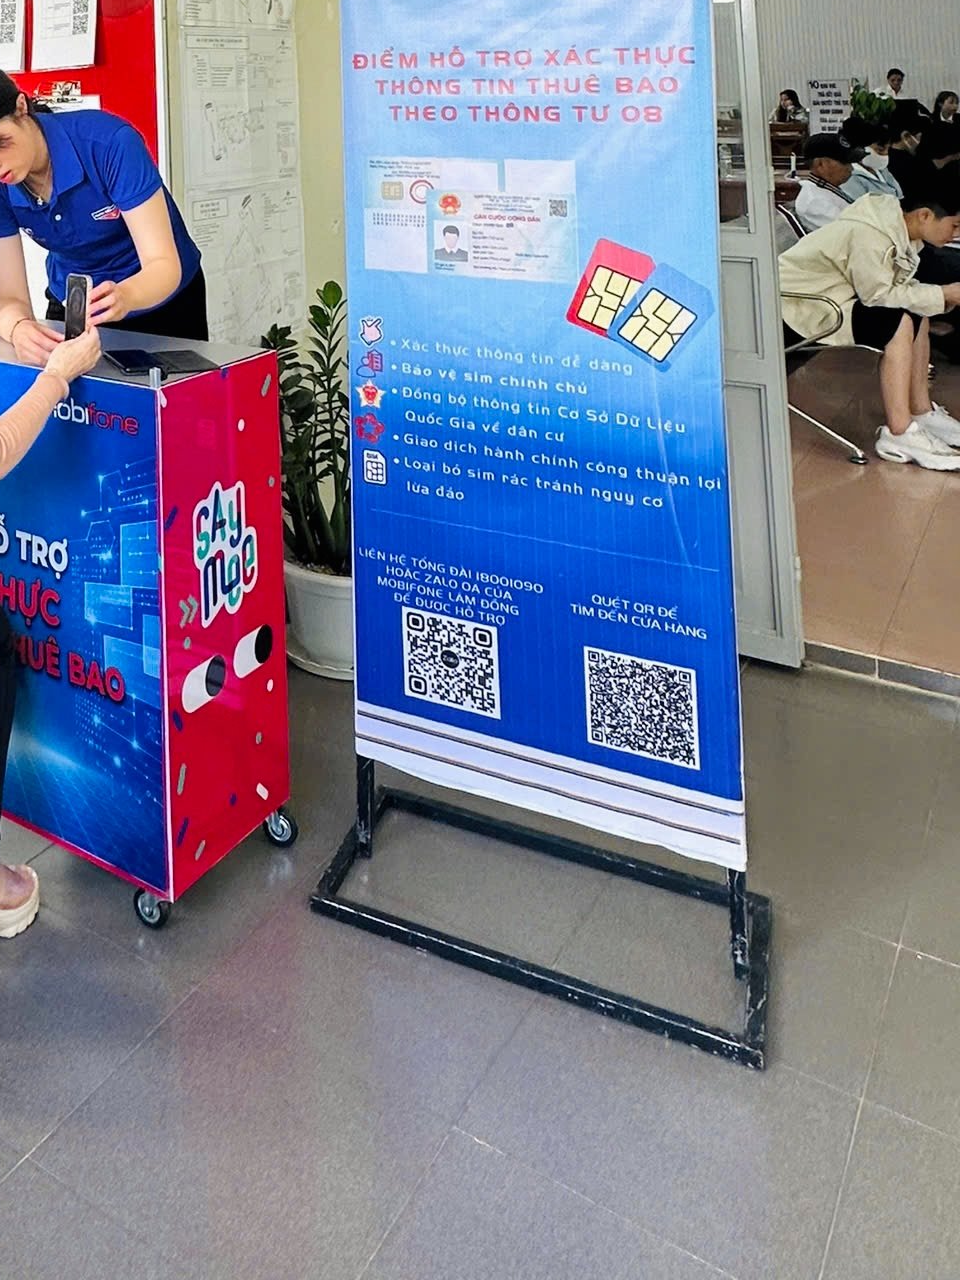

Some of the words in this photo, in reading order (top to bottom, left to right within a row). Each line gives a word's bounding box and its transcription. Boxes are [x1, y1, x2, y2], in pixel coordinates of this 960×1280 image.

[352, 46, 418, 70] ĐIỂM
[430, 45, 466, 68] HỖ
[476, 48, 532, 70] TRỢ
[543, 44, 602, 67] XÁC
[614, 44, 696, 69] THỰC
[375, 76, 461, 95] THÔNG
[472, 78, 515, 95] TIN
[527, 73, 601, 95] THUÊ
[615, 76, 679, 94] BAO
[389, 105, 458, 121] THEO
[467, 102, 560, 122] THÔNG
[572, 104, 610, 123] TƯ
[621, 105, 663, 123] 08
[401, 338, 429, 352] Xác
[435, 341, 470, 357] thực
[476, 346, 524, 364] thông
[531, 352, 554, 365] tin
[464, 371, 493, 384] sim
[53, 397, 139, 435] obifone
[448, 390, 467, 406] bộ
[474, 395, 520, 415] thông
[528, 402, 551, 416] tin
[557, 405, 580, 420] Cơ
[586, 408, 609, 424] Sở
[615, 412, 640, 428] Dữ
[647, 417, 687, 434] Liệu
[405, 410, 444, 426] Quốc
[449, 416, 476, 431] Gia
[482, 419, 501, 434] về
[507, 422, 538, 439] dân
[545, 430, 565, 443] cư
[403, 432, 438, 449] Giao
[443, 439, 478, 456] dịch
[483, 445, 525, 462] hành
[531, 452, 579, 470] chính
[585, 461, 628, 479] công
[635, 467, 690, 487] thuận
[698, 475, 722, 492] lợi
[404, 456, 436, 473] Loại
[442, 461, 461, 477] bỏ
[467, 467, 495, 482] sim
[501, 473, 529, 488] rác
[535, 476, 584, 496] tránh
[591, 487, 635, 506] nguy
[642, 495, 664, 508] cơ
[406, 480, 430, 496] lừa
[15, 528, 69, 580] TRỢ
[359, 547, 386, 561] LIÊN
[449, 564, 472, 579] ĐÀI
[476, 571, 544, 594] 18001090
[377, 575, 444, 599] MOBIFONE
[424, 573, 458, 589] ZALO
[461, 581, 481, 594] OA
[484, 584, 513, 601] CỦA
[478, 610, 506, 627] TRỢ
[591, 593, 630, 610] QUÉT
[633, 602, 655, 615] QR
[658, 605, 679, 620] ĐỂ
[570, 602, 595, 617] TÌM
[598, 607, 628, 624] ĐẾN
[631, 615, 662, 631] CỬA
[664, 620, 708, 640] HÀNG
[14, 634, 61, 678] HUÊ
[68, 651, 125, 702] BAO
